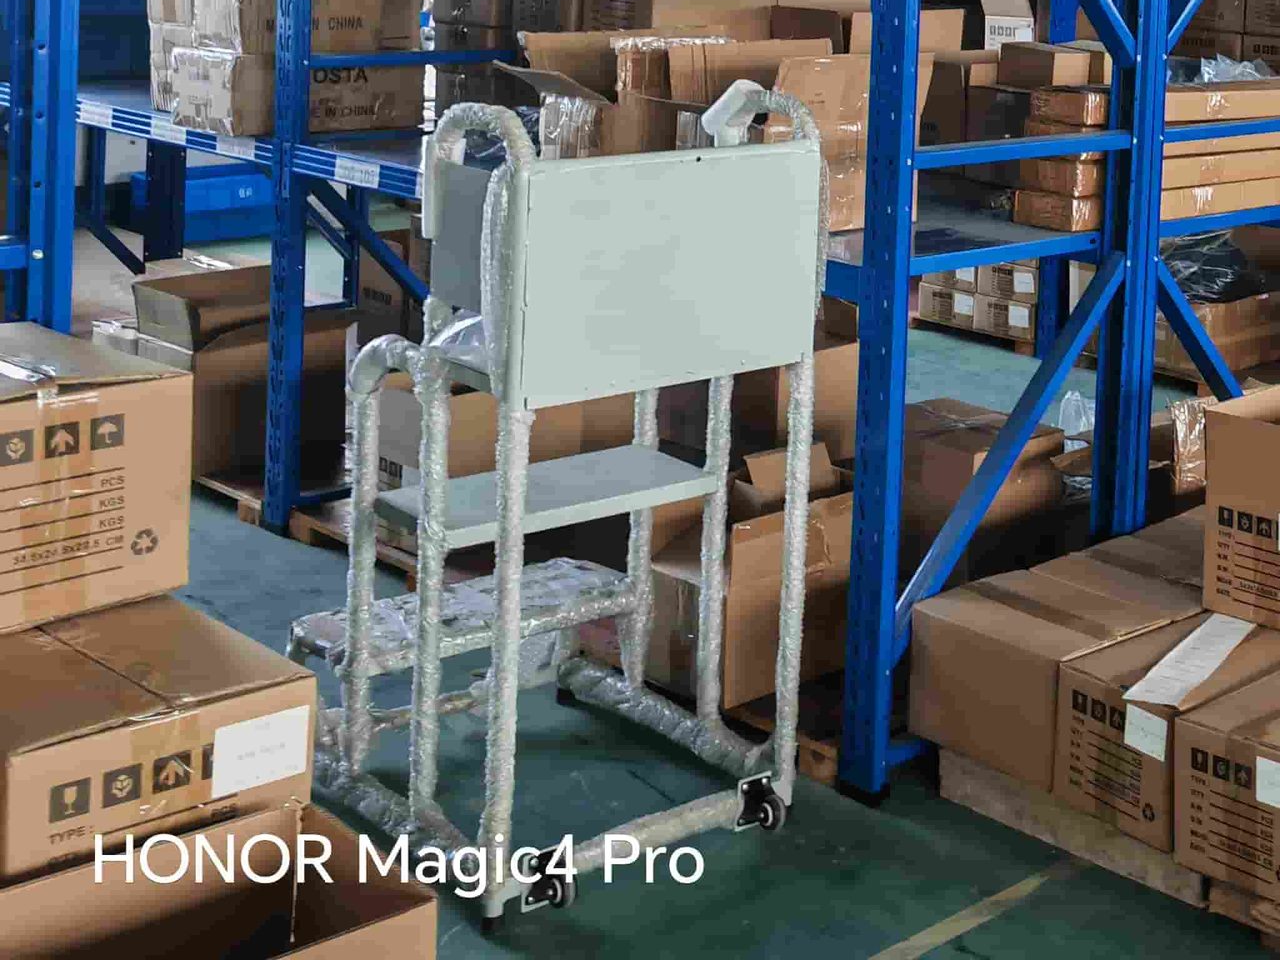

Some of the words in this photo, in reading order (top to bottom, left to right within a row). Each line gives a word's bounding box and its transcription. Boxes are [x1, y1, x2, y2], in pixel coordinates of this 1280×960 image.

[328, 17, 363, 31] CHINA
[313, 68, 368, 84] OSTA
[100, 475, 125, 488] PCS
[99, 496, 125, 509] KGS
[99, 516, 125, 528] KGS
